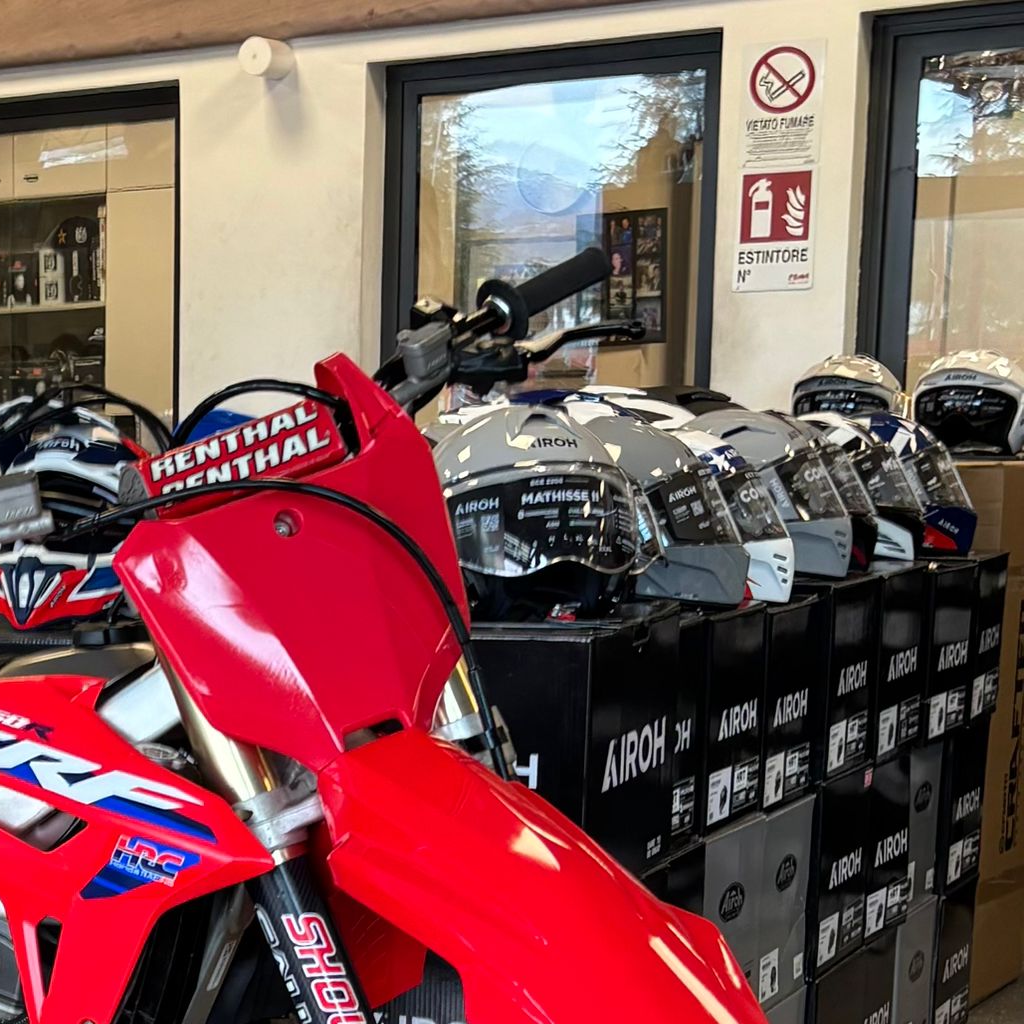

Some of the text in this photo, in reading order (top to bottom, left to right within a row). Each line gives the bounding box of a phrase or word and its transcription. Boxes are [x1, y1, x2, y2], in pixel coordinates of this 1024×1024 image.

[745, 115, 815, 132] VIETATO FUMARE
[738, 247, 808, 264] ESTINTORE
[944, 372, 978, 382] AIROH
[150, 405, 318, 482] RENTHAL
[455, 497, 500, 516] AIROH
[521, 489, 589, 506] MATHISSE
[668, 486, 697, 503] AIROH
[937, 640, 969, 672] AIROH
[978, 624, 1000, 654] AIROH
[837, 660, 867, 696] AIROH
[887, 647, 918, 682] AIROH
[718, 698, 757, 742] AIROH
[773, 688, 808, 728] AIROH
[601, 715, 667, 794] AIROH
[956, 787, 980, 821] AIROH
[110, 835, 185, 881] HRC
[874, 827, 908, 868] AIROH
[828, 847, 862, 890] AIROH
[941, 944, 969, 983] AIROH
